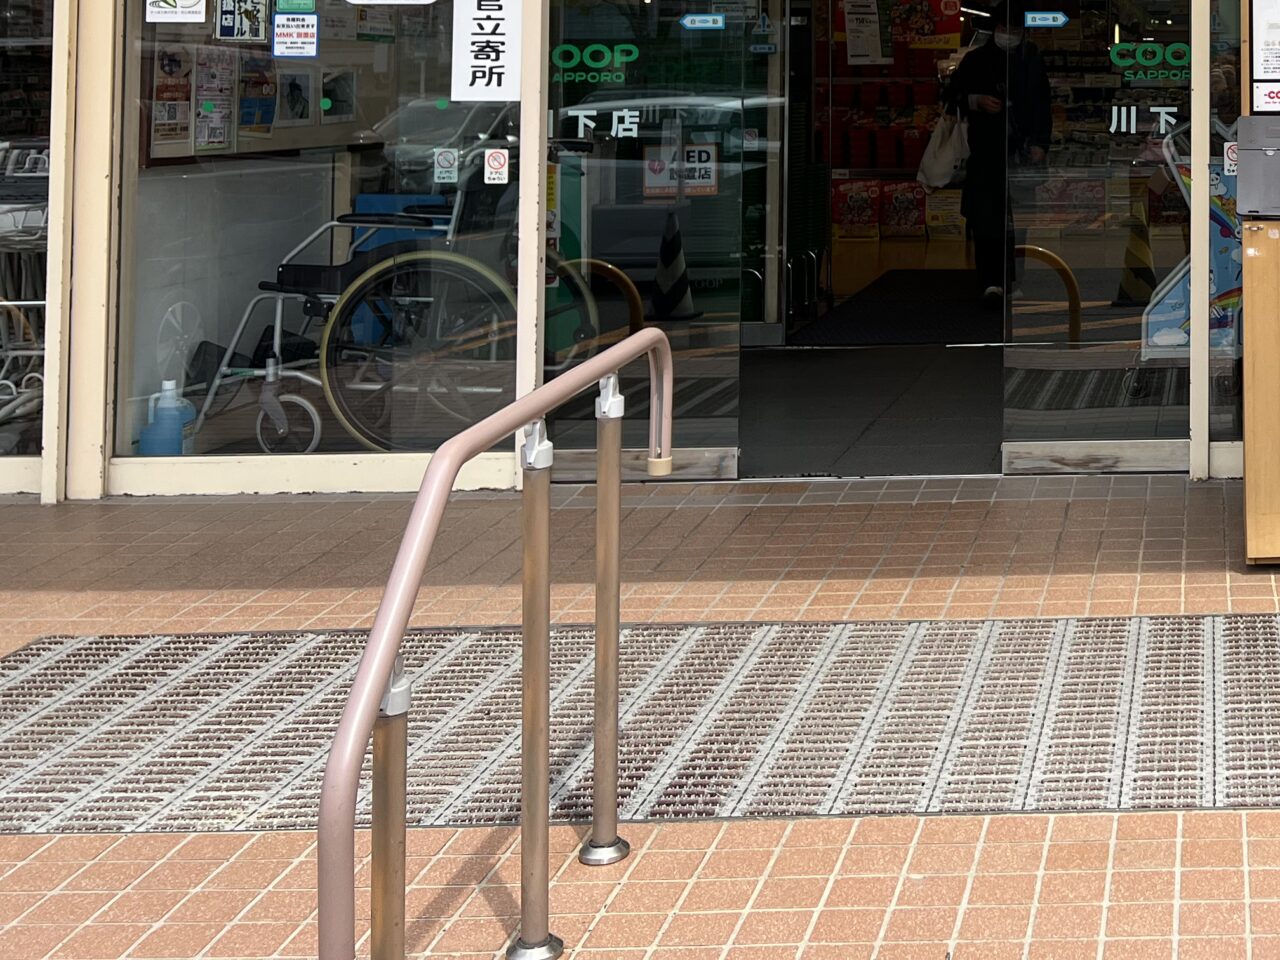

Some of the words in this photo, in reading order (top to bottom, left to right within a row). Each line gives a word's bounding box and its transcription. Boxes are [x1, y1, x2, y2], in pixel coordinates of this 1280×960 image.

[551, 43, 640, 69] OOP
[1109, 42, 1191, 67] COO
[552, 72, 625, 83] APPORO
[548, 109, 640, 138] 下店
[1109, 105, 1178, 134] 川下
